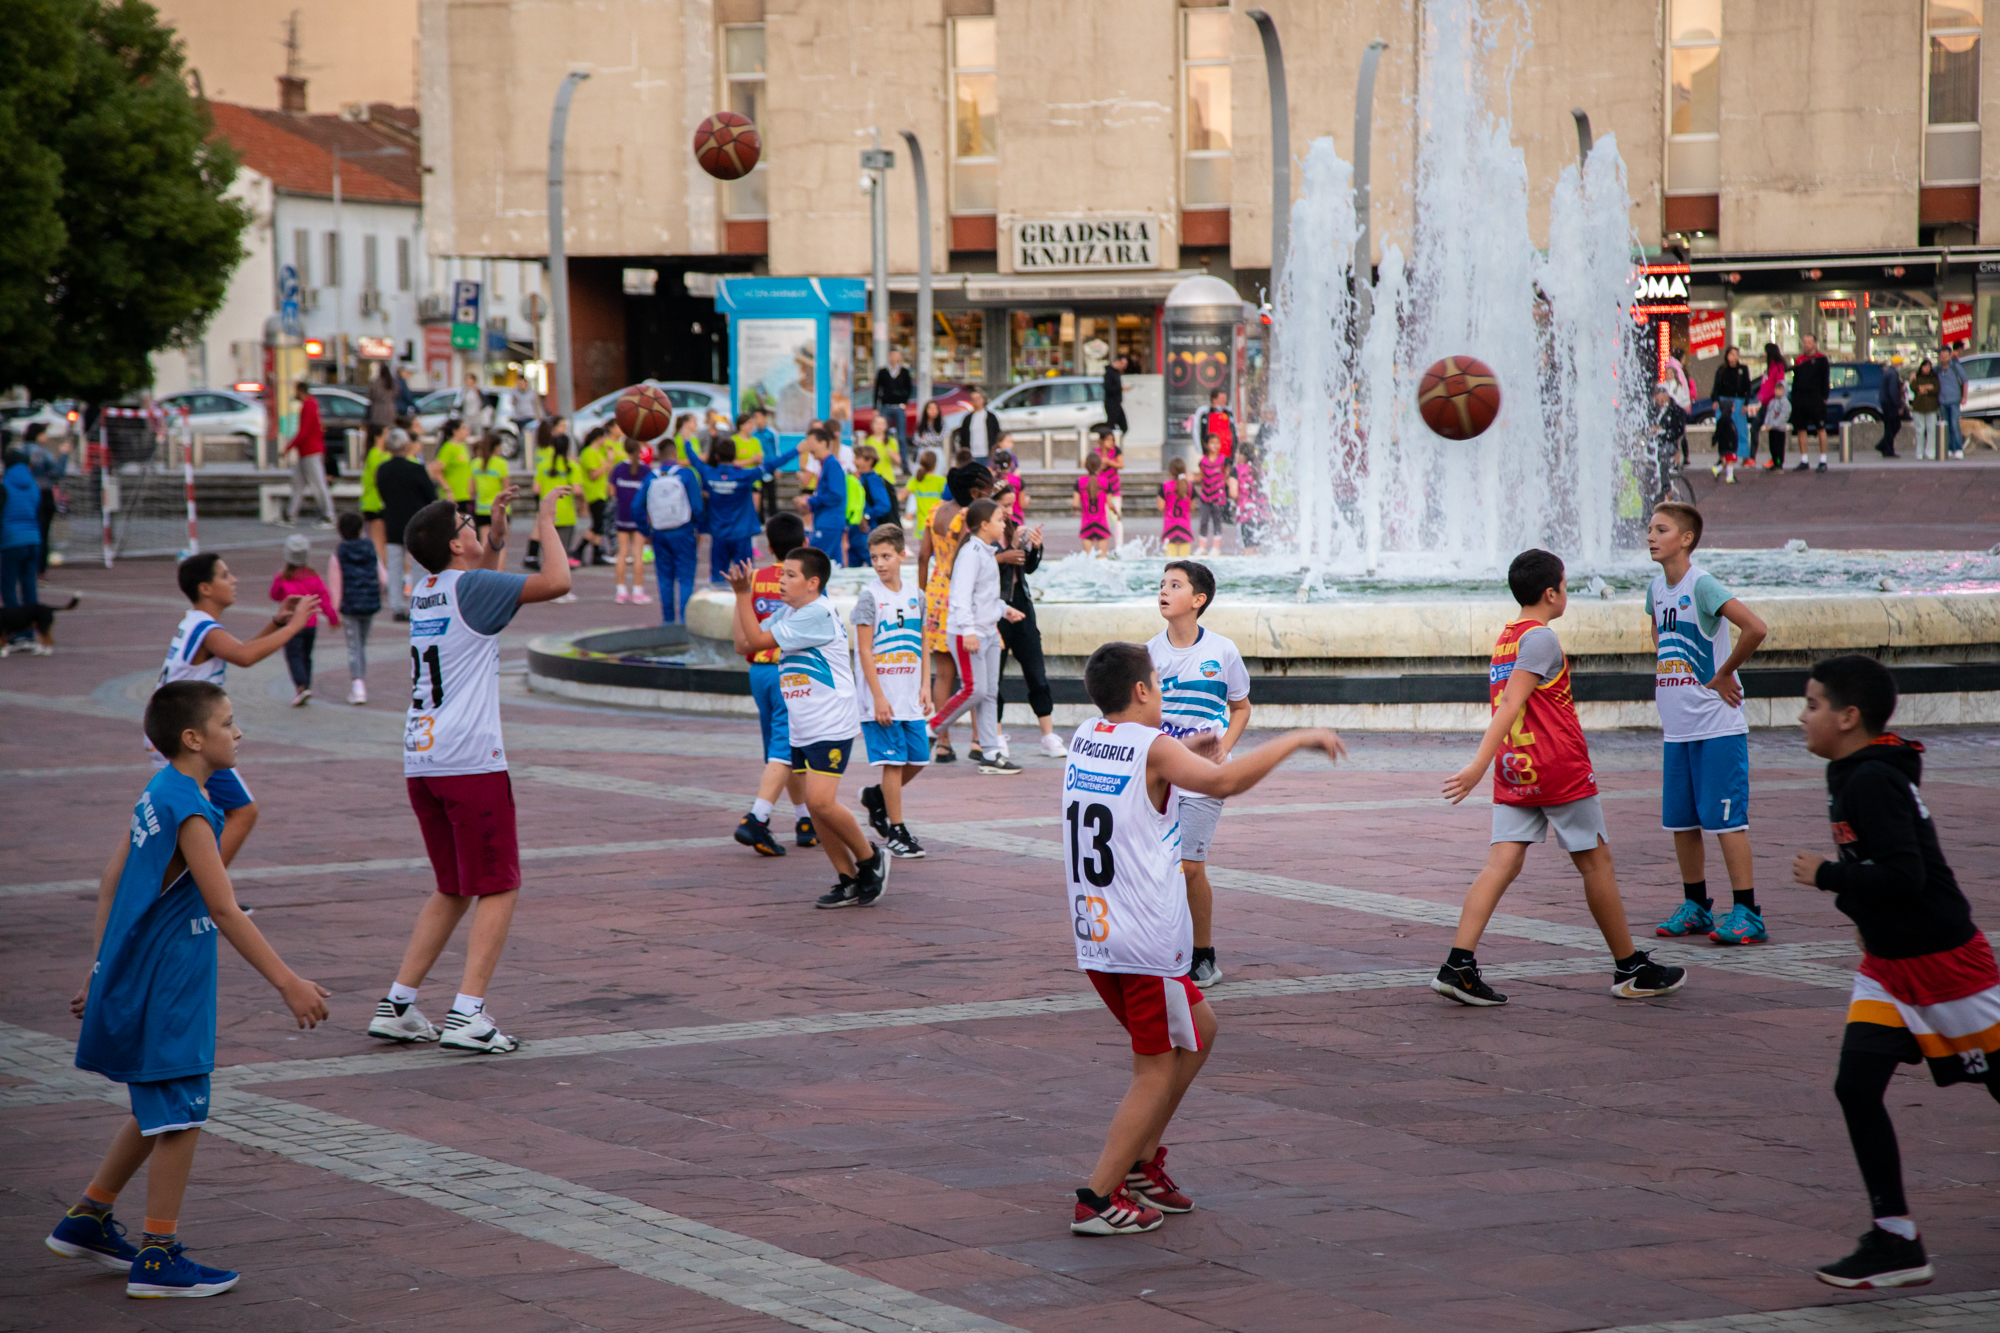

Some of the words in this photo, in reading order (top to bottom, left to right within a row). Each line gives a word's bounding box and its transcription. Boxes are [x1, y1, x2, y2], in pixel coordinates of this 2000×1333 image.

[1020, 221, 1150, 243] GRADSKA
[1173, 498, 1183, 518] 6
[896, 608, 904, 629] 5
[1662, 607, 1678, 633] 10
[1721, 799, 1731, 821] 7
[1066, 800, 1115, 888] 13
